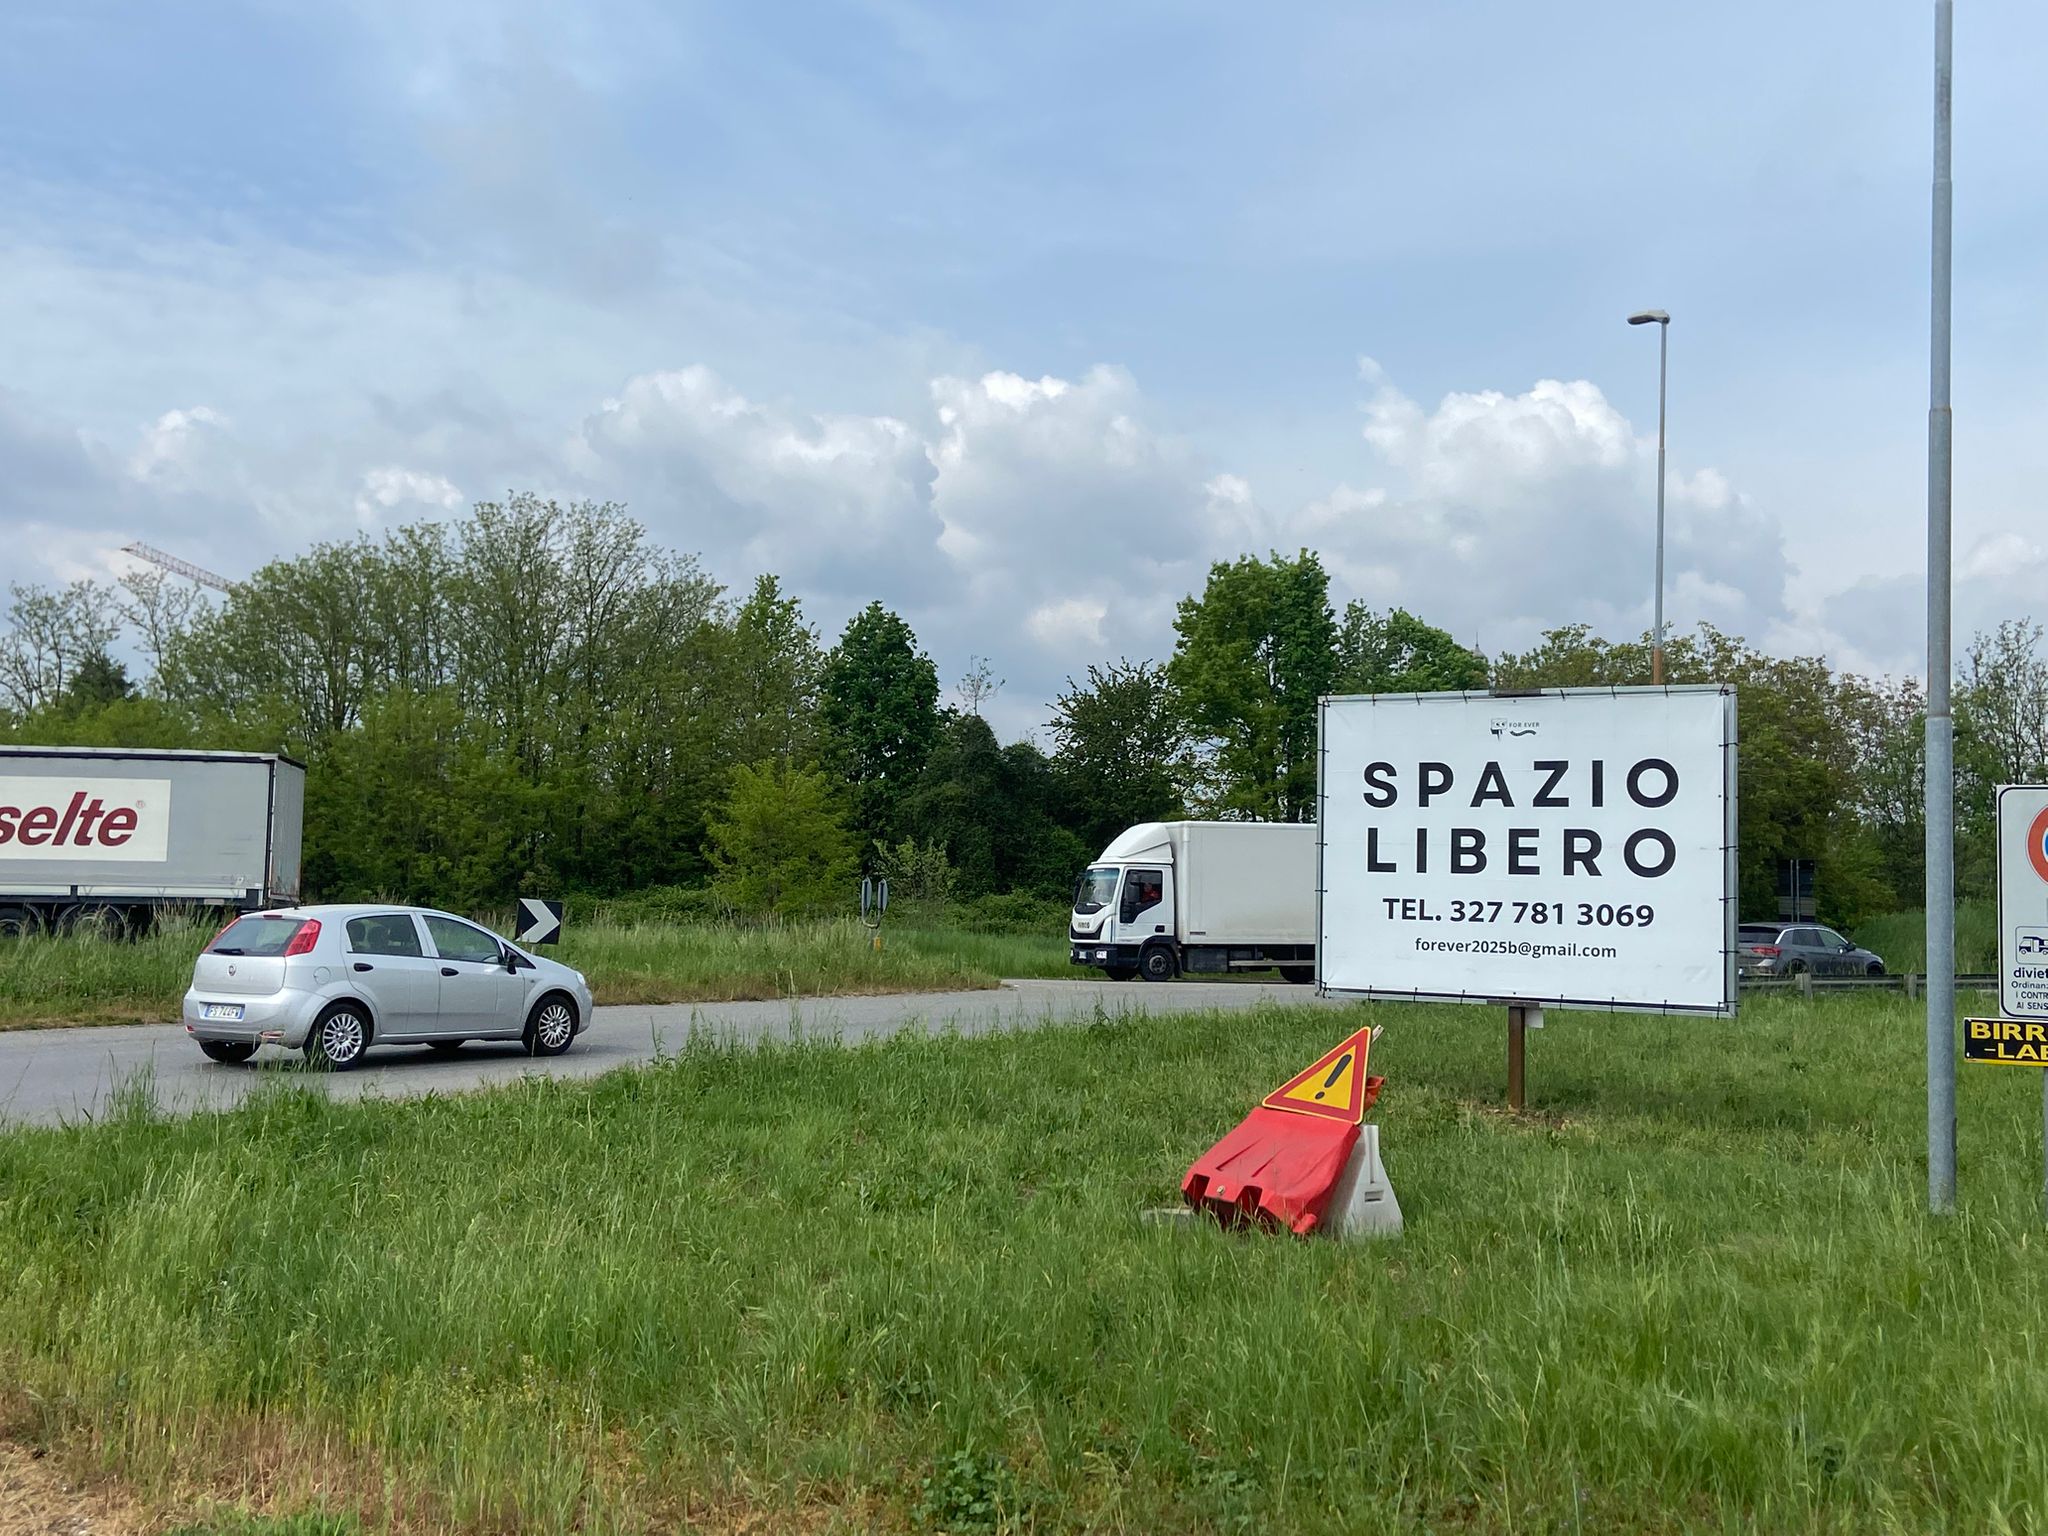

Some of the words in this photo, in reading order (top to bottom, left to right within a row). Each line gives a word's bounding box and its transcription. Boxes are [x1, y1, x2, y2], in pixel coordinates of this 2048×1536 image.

[1363, 758, 1679, 809] SPAZIO
[0, 791, 138, 847] selte
[1367, 827, 1677, 879] LIBERO
[1382, 897, 1442, 922] TEL.
[1449, 900, 1503, 923] 327
[1512, 902, 1564, 925] 781
[1576, 903, 1655, 928] 3069
[1415, 937, 1617, 959] forever2025b@gmail.com
[1971, 1022, 2047, 1042] BIRR
